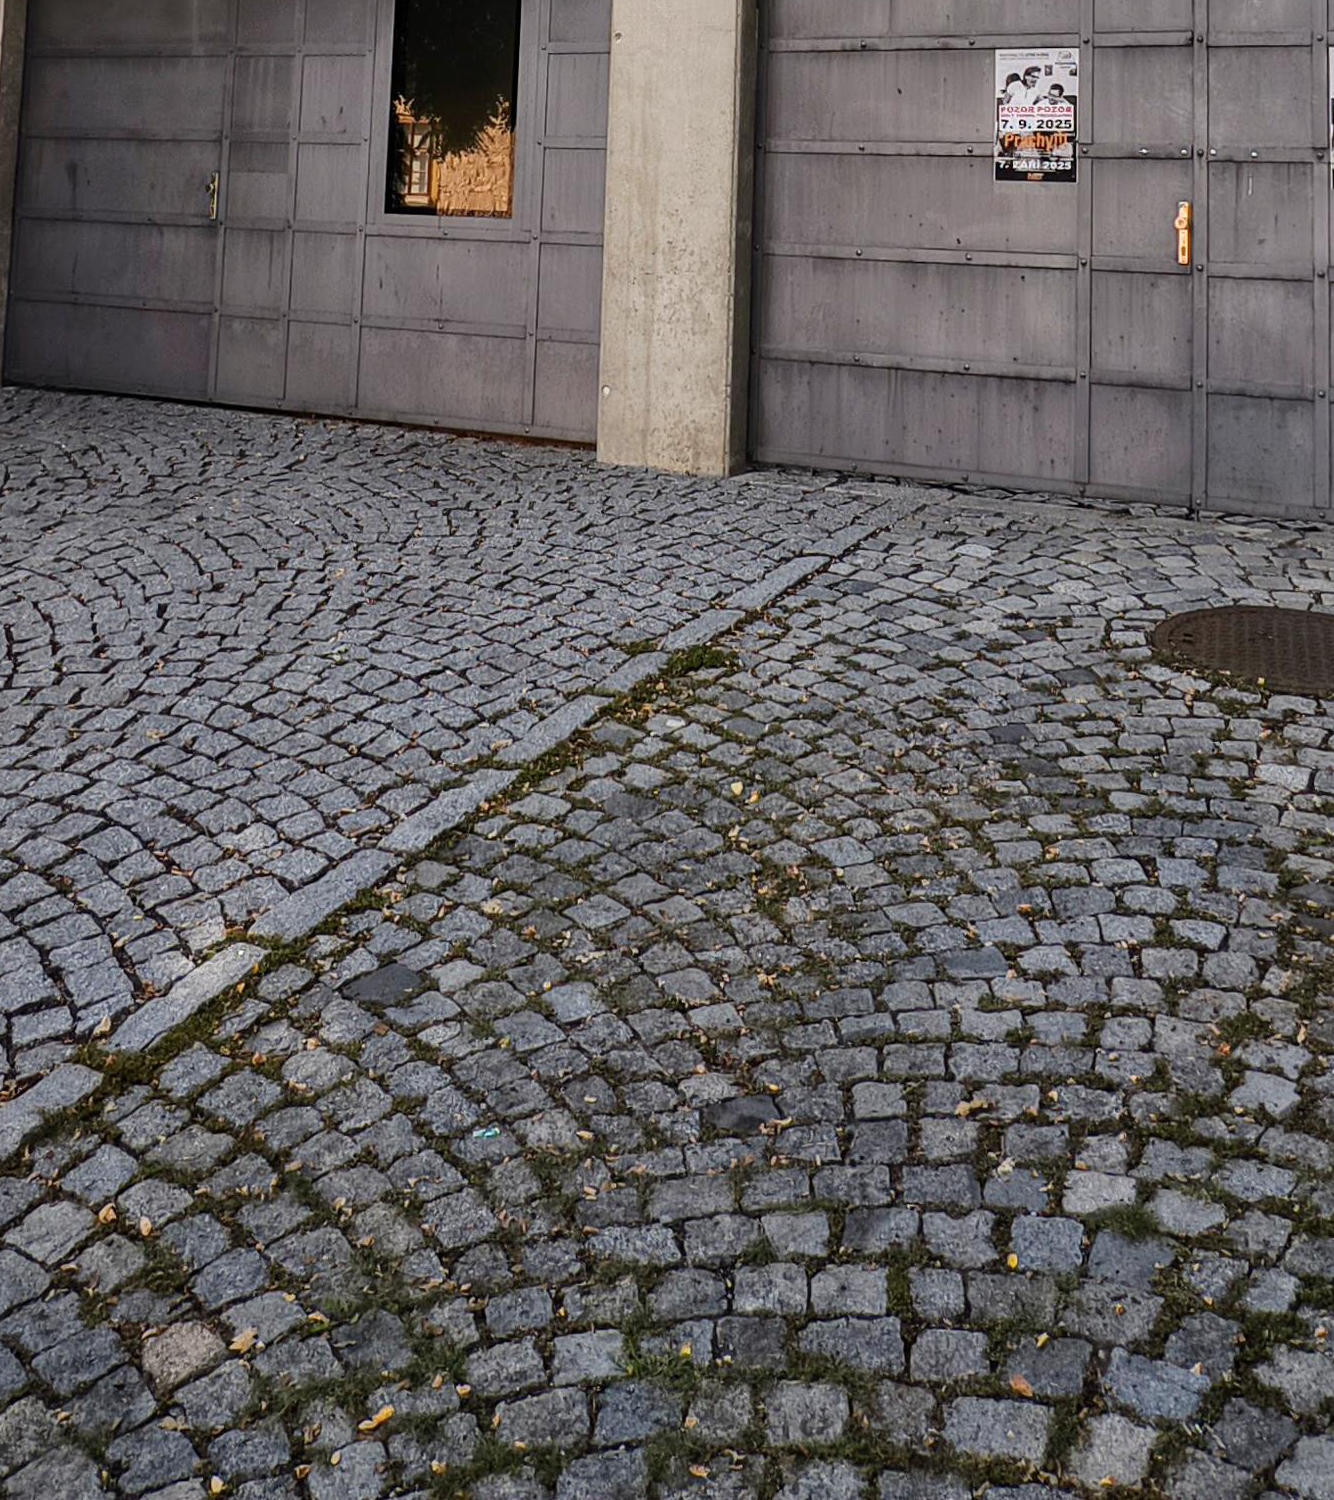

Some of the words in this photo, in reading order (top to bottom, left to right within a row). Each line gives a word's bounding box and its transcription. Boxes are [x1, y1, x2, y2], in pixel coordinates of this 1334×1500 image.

[1001, 119, 1013, 129] 7.
[1018, 119, 1032, 129] 9.
[1036, 119, 1072, 129] 2025
[1042, 161, 1072, 170] 2025
